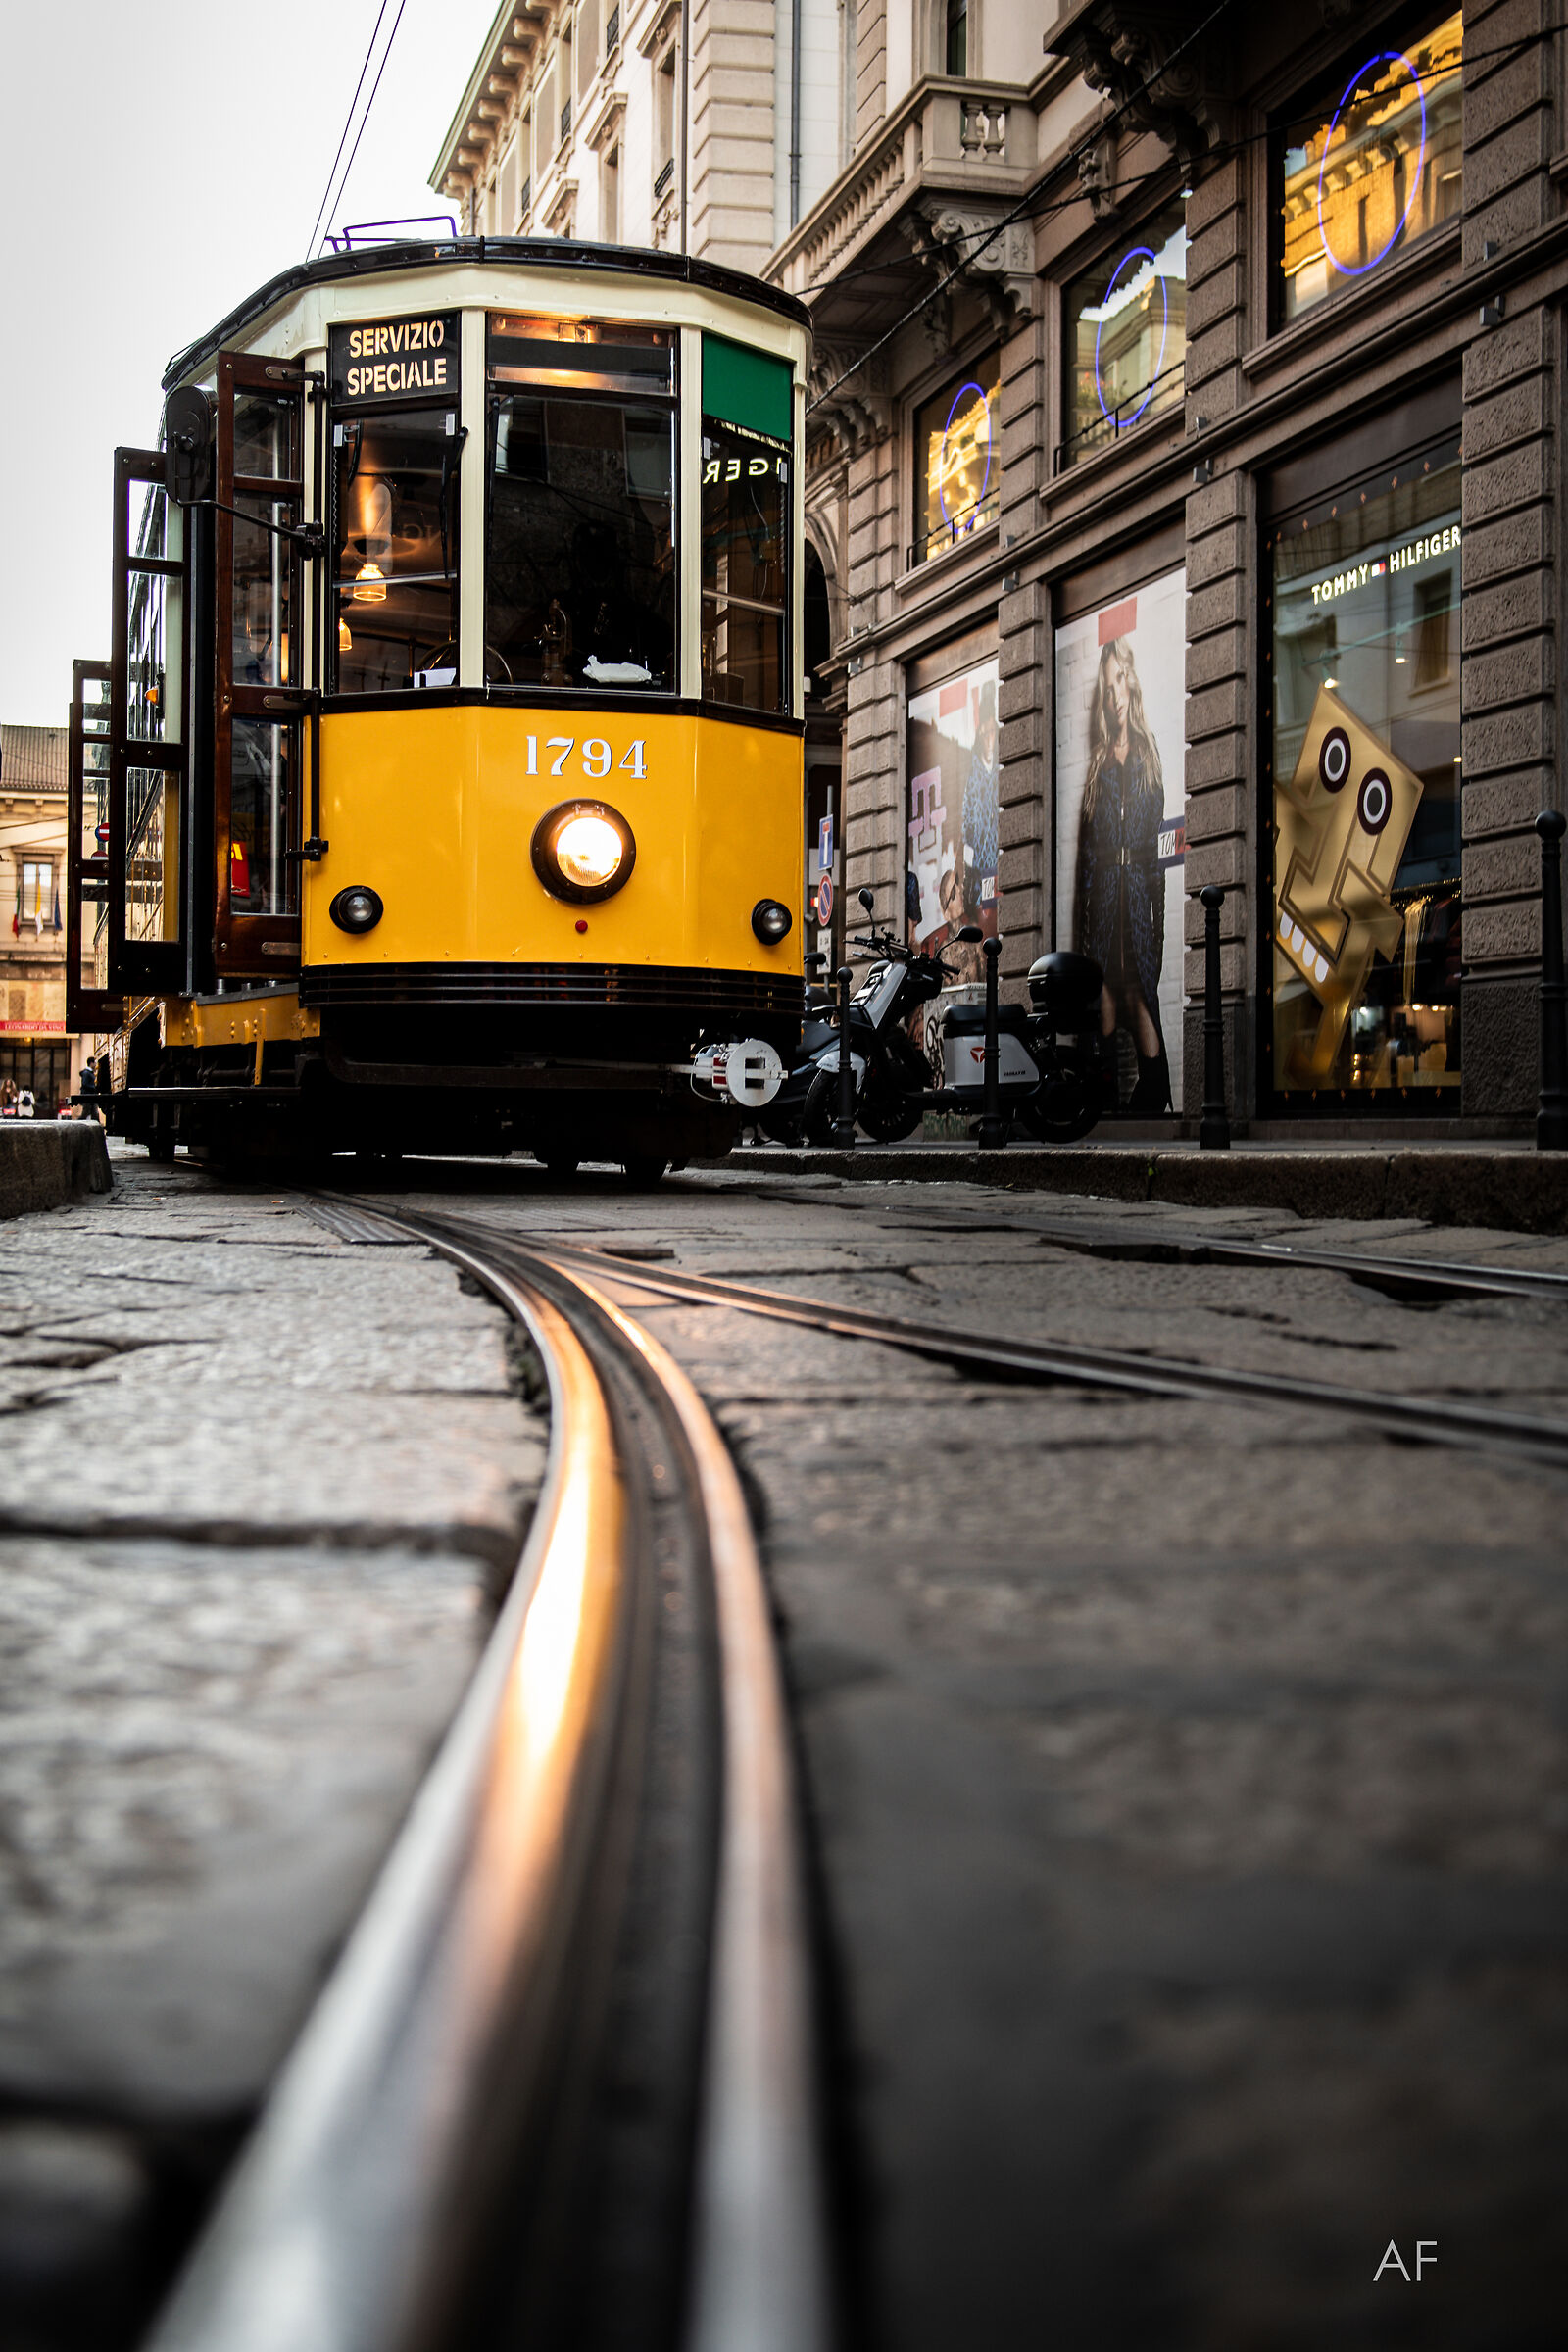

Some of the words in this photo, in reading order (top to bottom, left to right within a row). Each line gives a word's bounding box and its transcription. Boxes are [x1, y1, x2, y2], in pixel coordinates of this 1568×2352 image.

[349, 319, 445, 359] SERVIZIO
[347, 357, 447, 396] SPECIALE
[1311, 563, 1369, 606] TOMMY
[1389, 524, 1462, 574] HILFIGER
[525, 735, 648, 779] 1794
